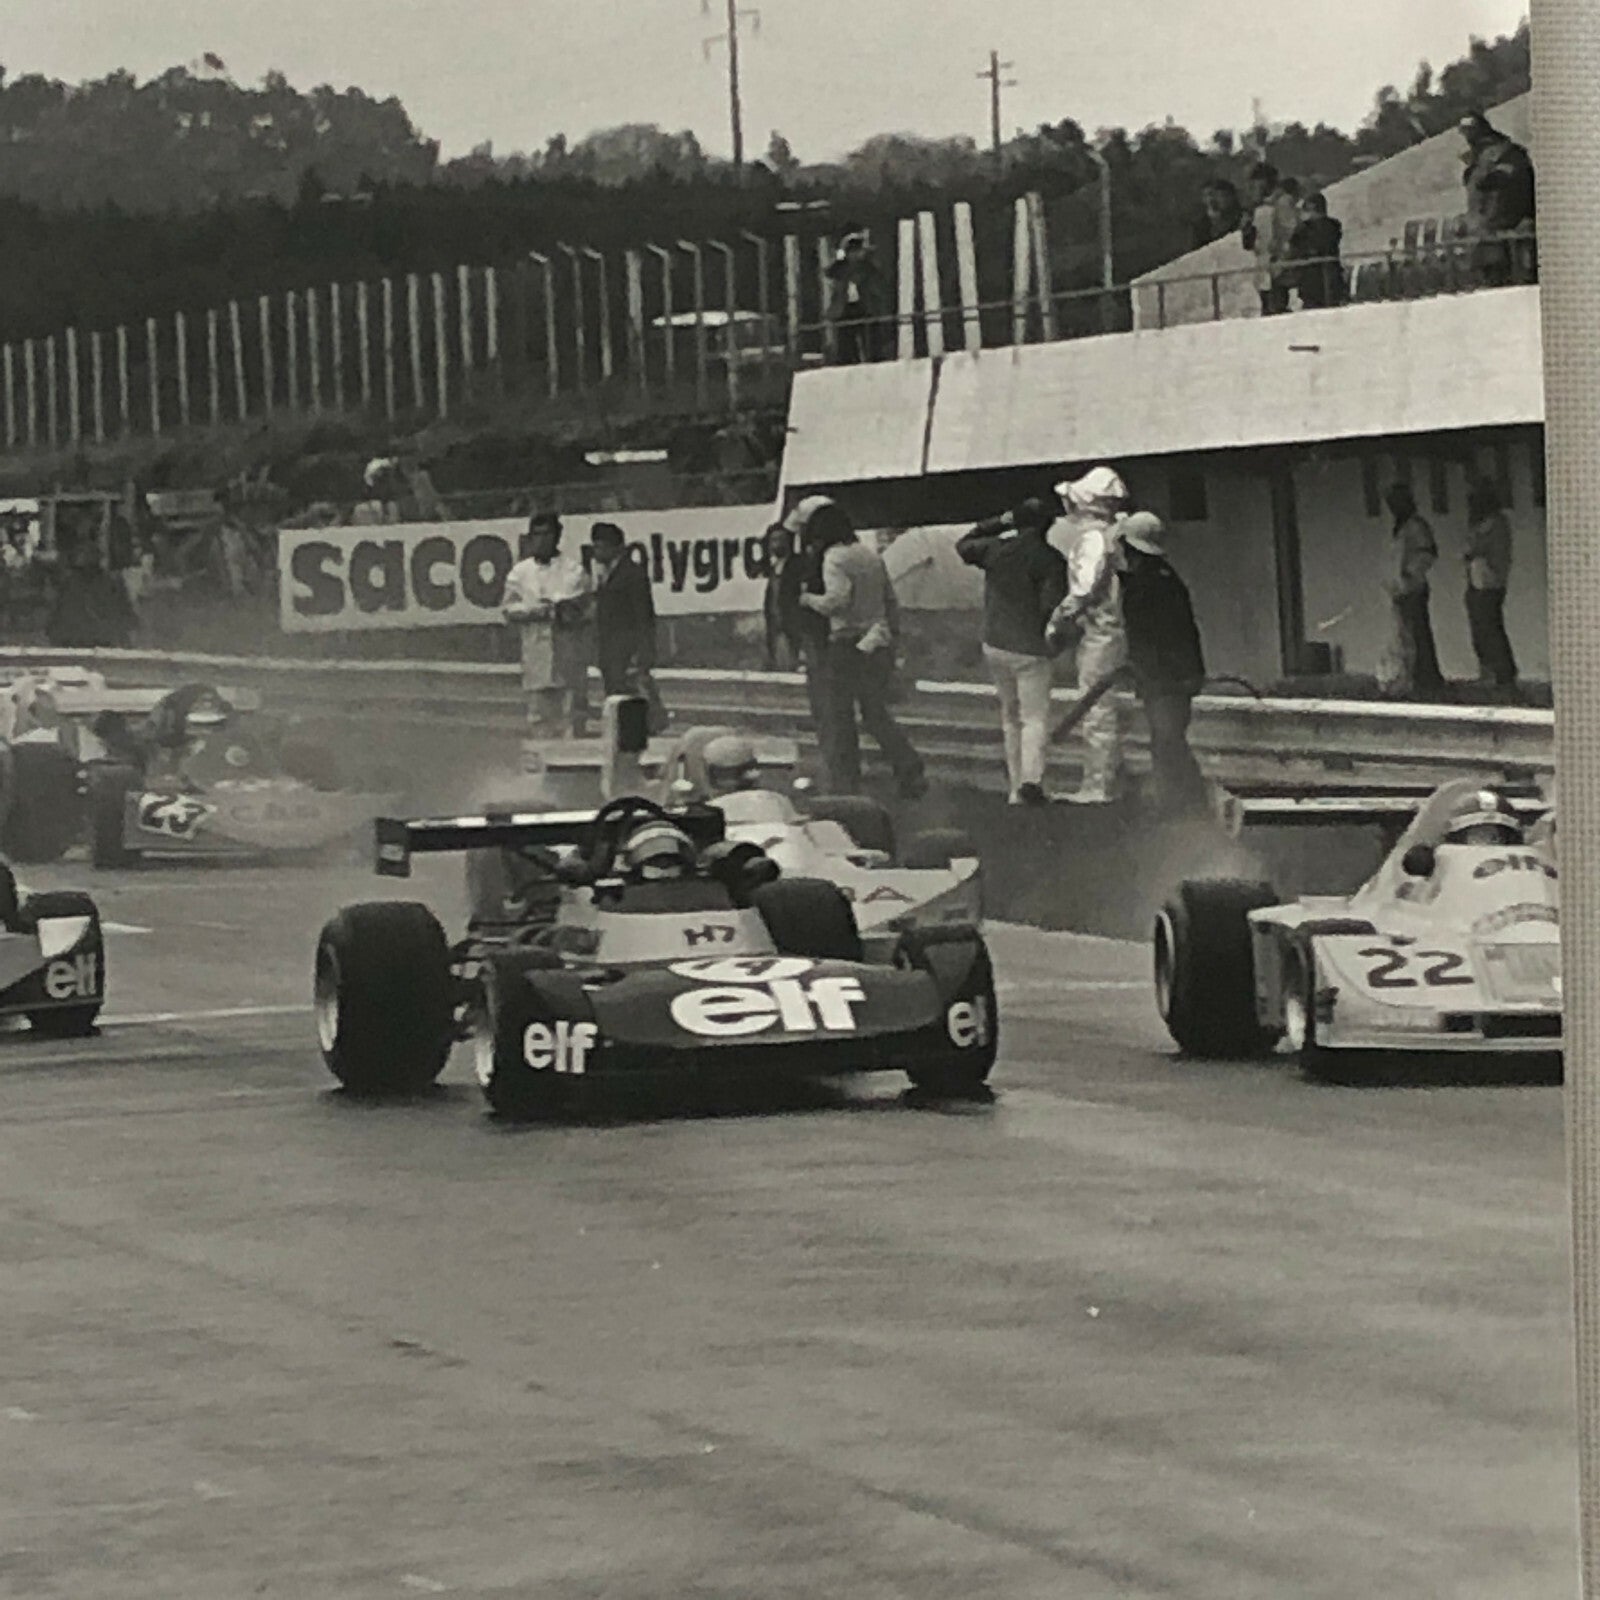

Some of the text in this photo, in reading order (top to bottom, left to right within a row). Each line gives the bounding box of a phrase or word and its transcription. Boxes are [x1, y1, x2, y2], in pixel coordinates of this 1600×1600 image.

[580, 533, 770, 593] olygra
[1358, 948, 1475, 987] 22
[671, 977, 867, 1036] elf
[947, 995, 987, 1047] el
[523, 1020, 599, 1073] elf
